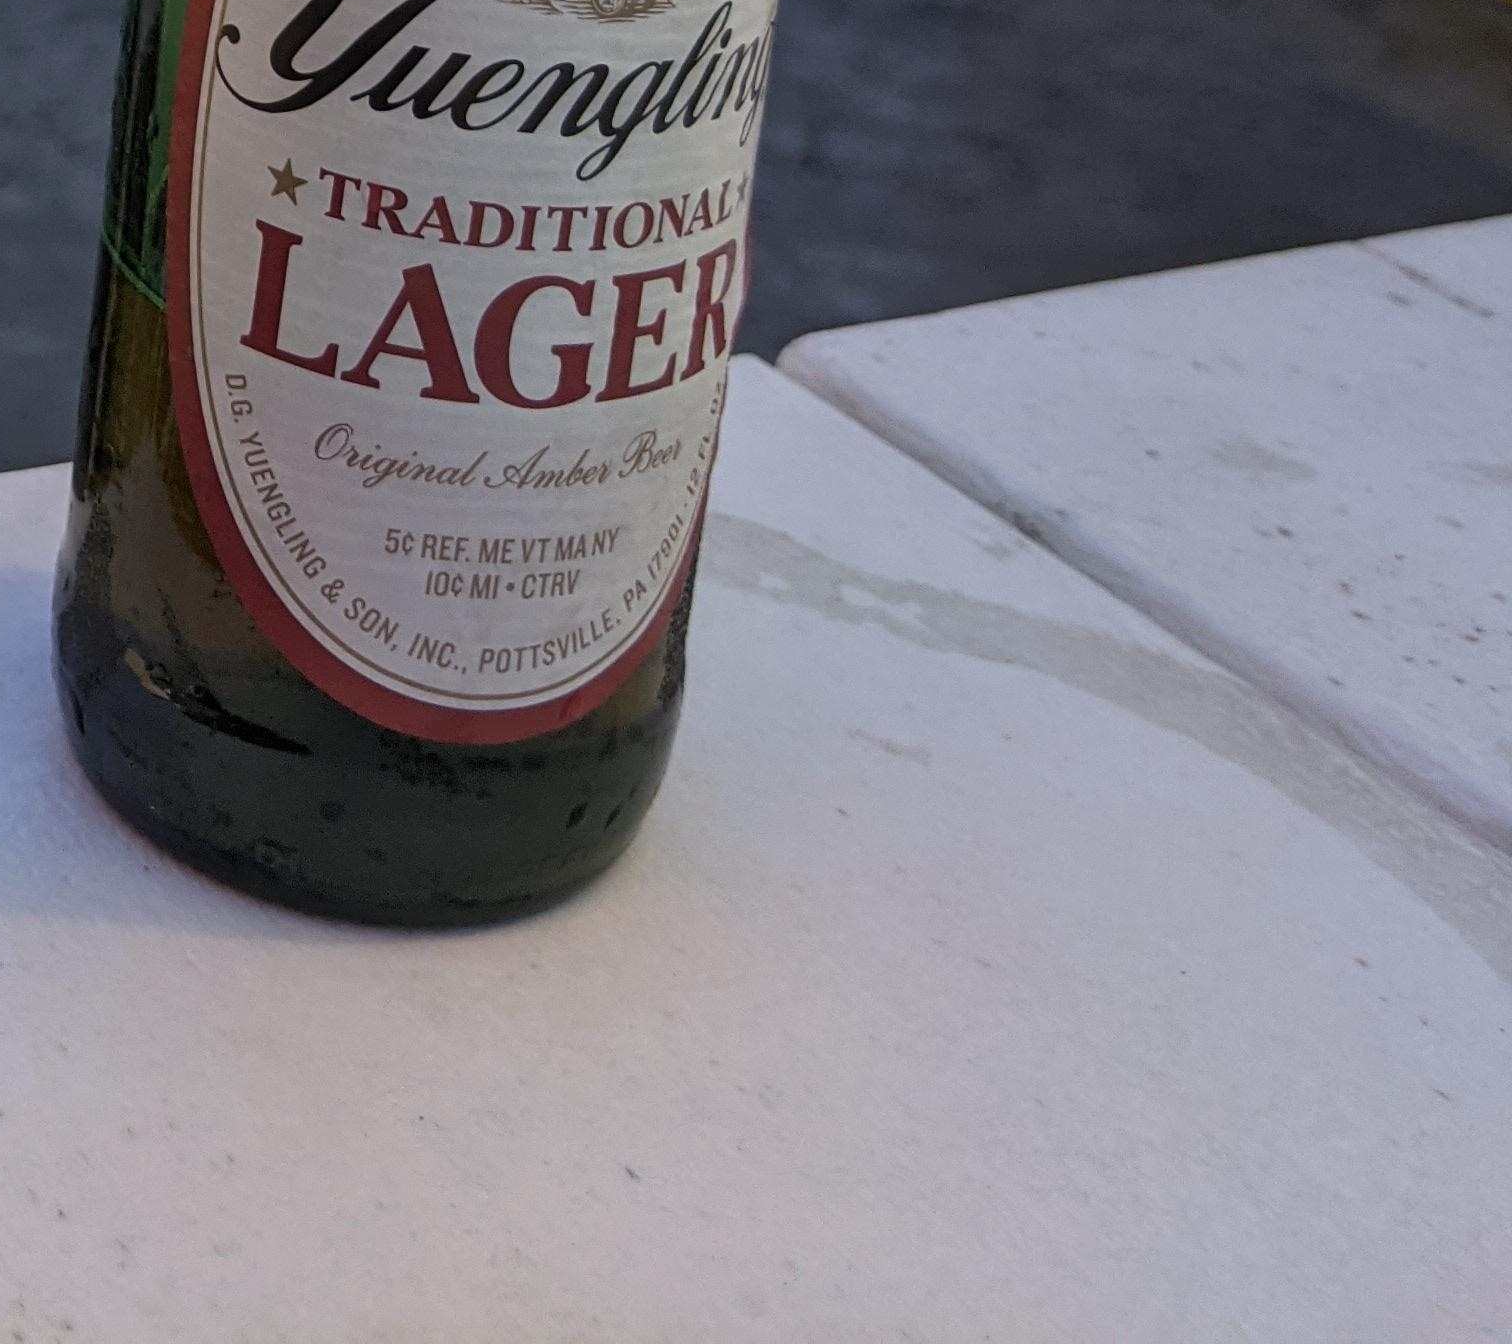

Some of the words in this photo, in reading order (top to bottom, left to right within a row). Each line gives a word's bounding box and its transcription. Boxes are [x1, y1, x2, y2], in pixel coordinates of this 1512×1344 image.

[319, 168, 734, 253] TRADITIONAL
[239, 219, 737, 410] LAGER
[314, 423, 488, 488] Original
[484, 445, 612, 490] Amber
[618, 429, 683, 479] Beer
[225, 374, 253, 423] D.G.
[239, 430, 327, 580] YUENGLING
[320, 578, 345, 604] &
[344, 597, 399, 652] SON,
[622, 579, 648, 612] PA
[647, 514, 684, 580] 17901
[384, 528, 415, 556] 5¢
[421, 533, 470, 562] REF.
[478, 538, 515, 564] ME
[521, 538, 551, 562] VT
[554, 536, 587, 562] MA
[590, 527, 620, 556] NY
[469, 574, 500, 600] MI
